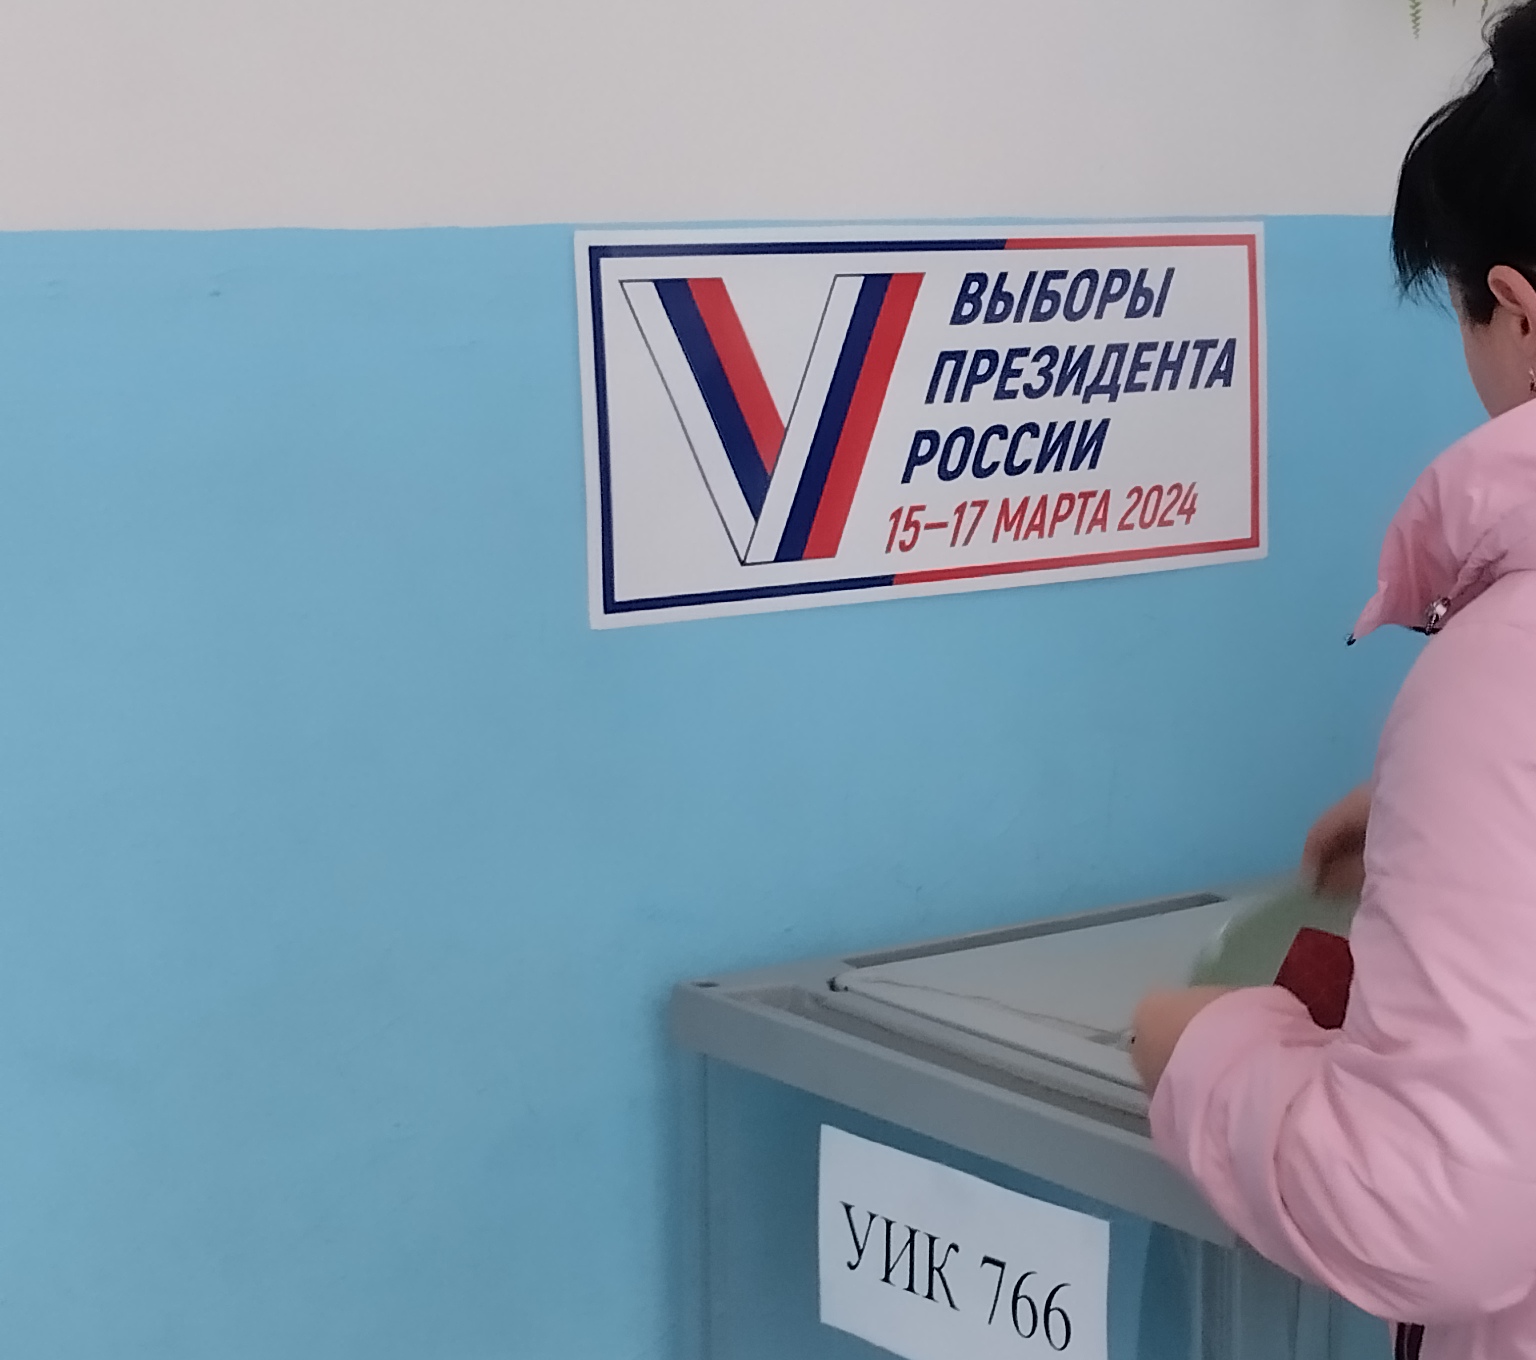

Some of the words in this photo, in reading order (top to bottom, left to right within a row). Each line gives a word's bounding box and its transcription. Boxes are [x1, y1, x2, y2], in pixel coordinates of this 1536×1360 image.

[950, 268, 1175, 325] ВЫБОРЫ
[925, 338, 1236, 404] ПРЕЗИДЕНТА
[901, 418, 1110, 484] РОССИИ
[993, 490, 1110, 543] МАРТА
[1118, 483, 1197, 530] 2024
[840, 1202, 959, 1310] УИК
[981, 1256, 1071, 1351] 766
